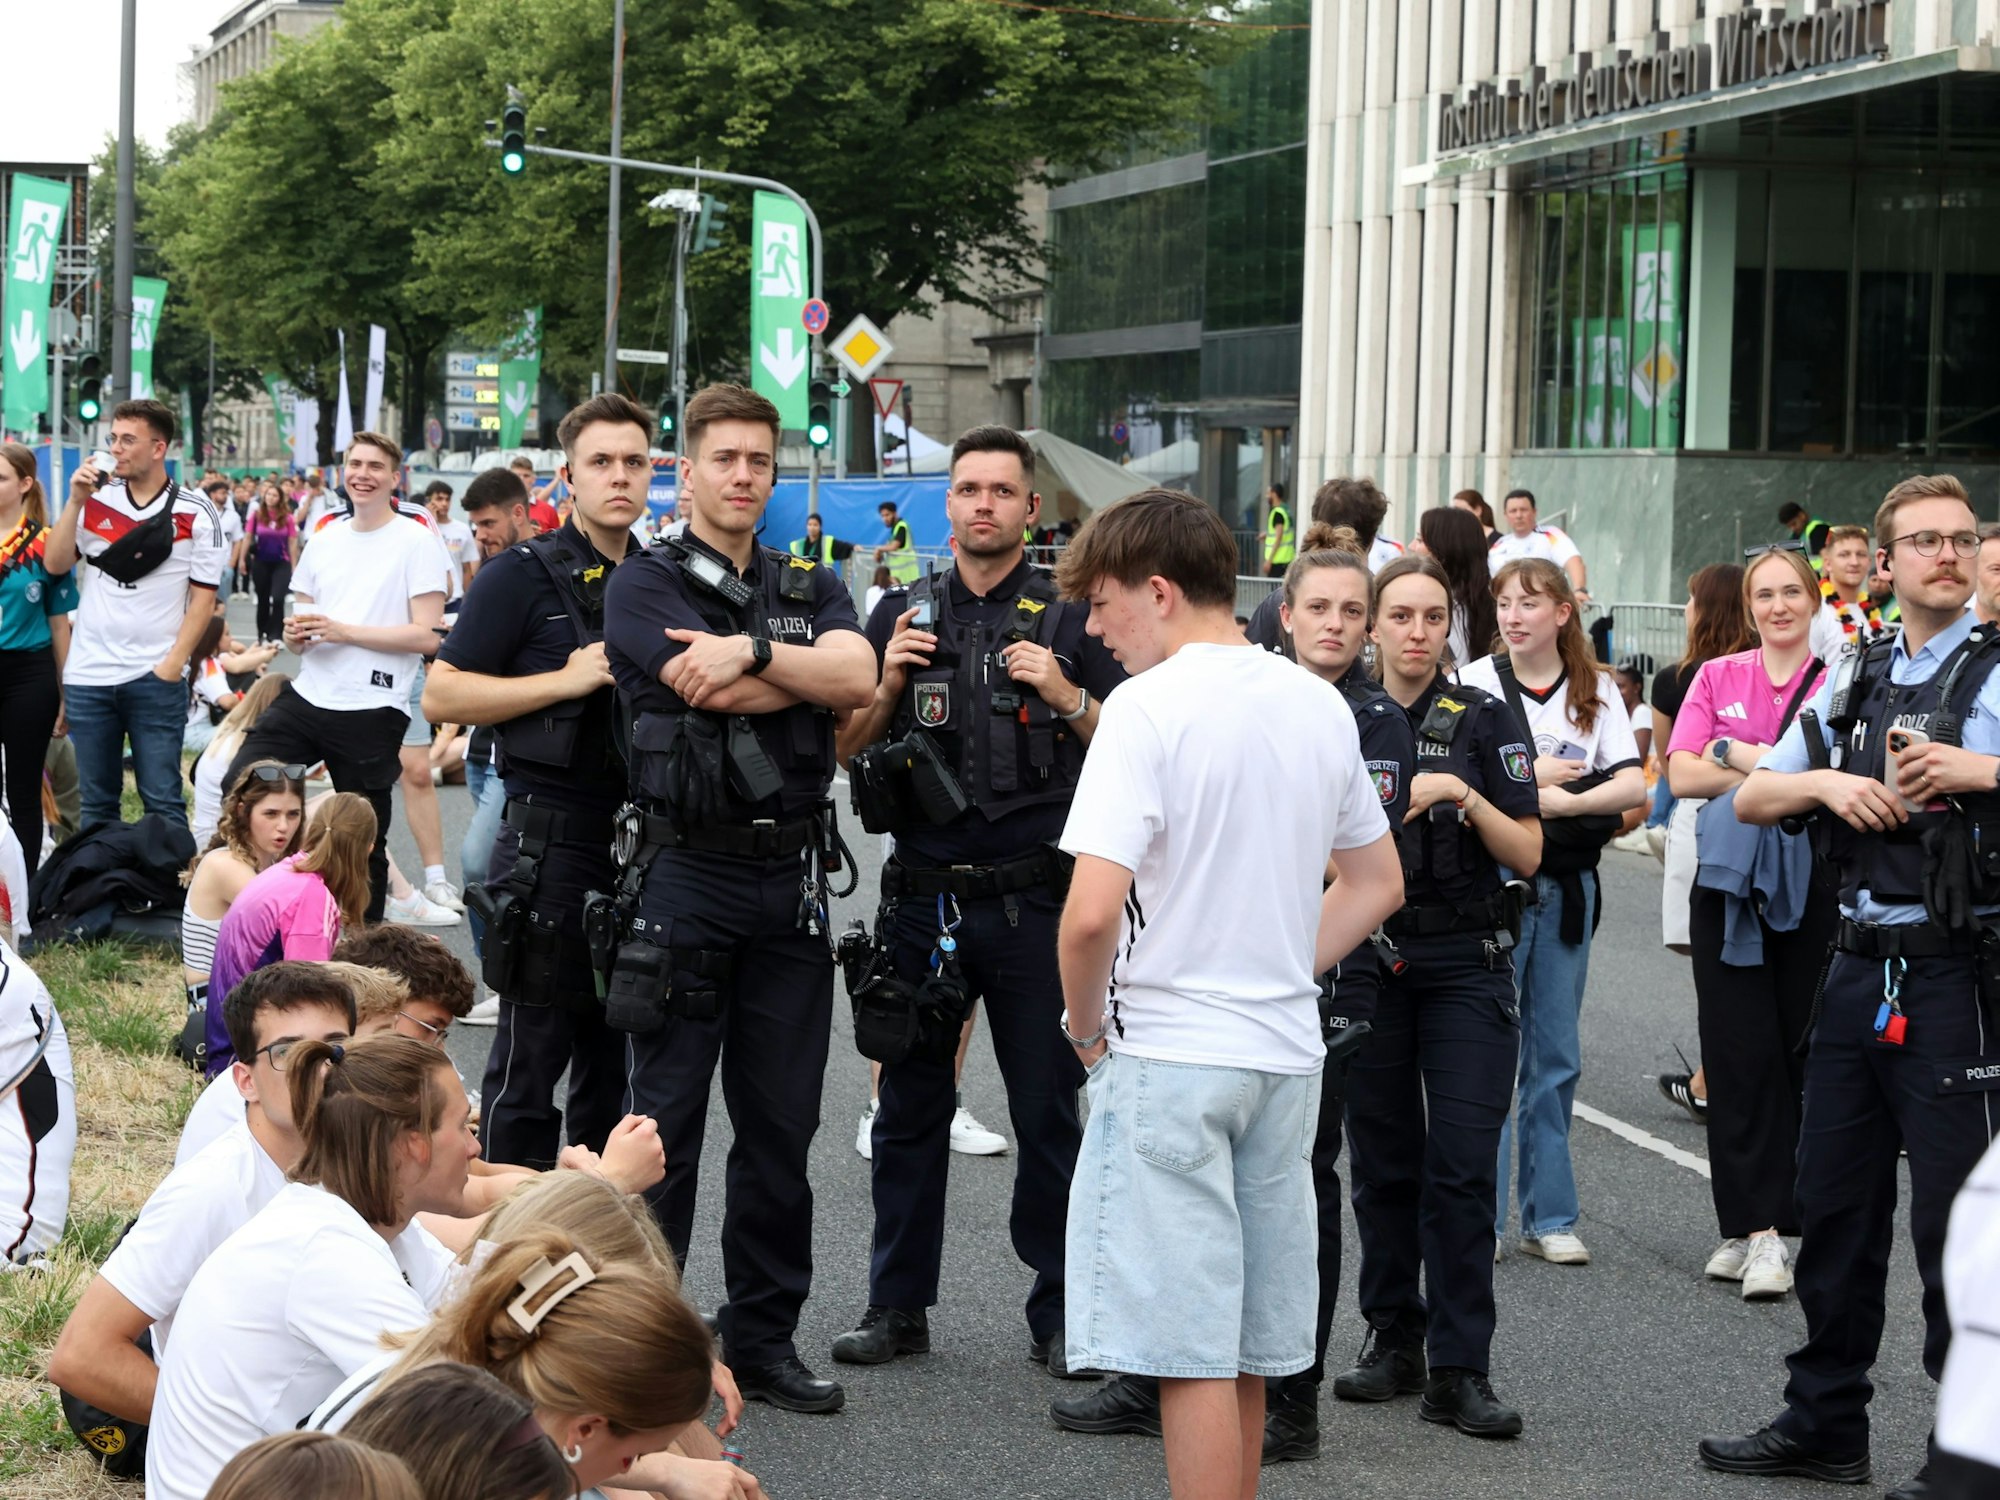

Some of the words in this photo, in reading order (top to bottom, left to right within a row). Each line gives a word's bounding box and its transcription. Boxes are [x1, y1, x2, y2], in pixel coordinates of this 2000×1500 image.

[1564, 32, 1711, 126] deutschen
[917, 684, 946, 694] POLIZEI
[1415, 740, 1450, 757] LIZEI
[1965, 1064, 2000, 1081] POLIZE
